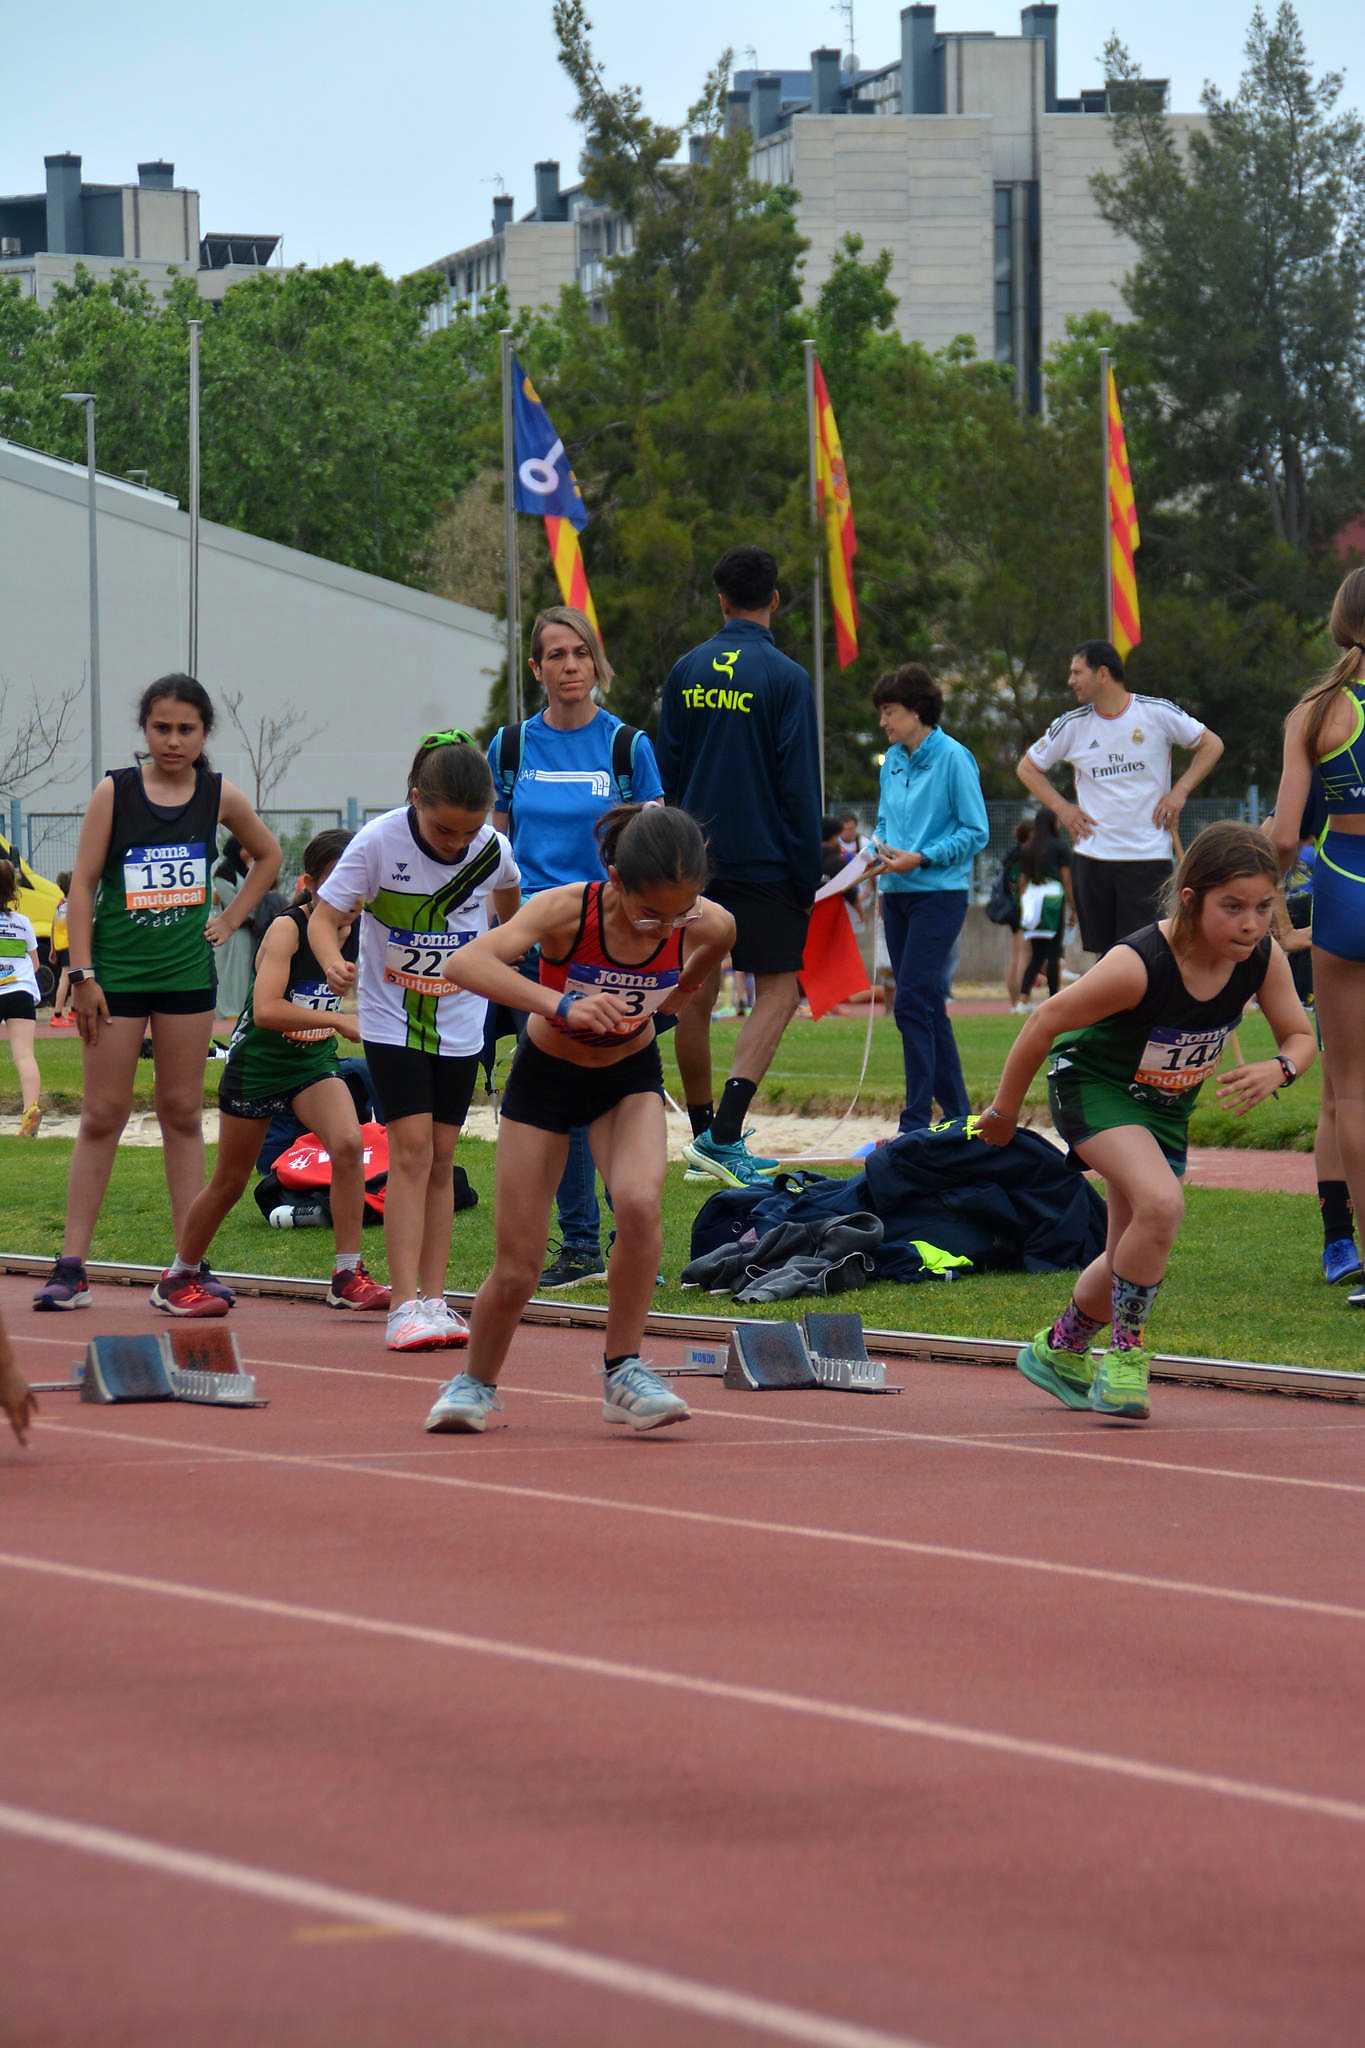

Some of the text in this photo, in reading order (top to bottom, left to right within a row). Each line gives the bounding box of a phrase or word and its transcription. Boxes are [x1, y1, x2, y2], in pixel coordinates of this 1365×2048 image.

[682, 683, 753, 713] TÈCNIC
[1091, 760, 1145, 778] Emirates
[1108, 753, 1124, 763] Fly
[141, 861, 195, 889] 136
[132, 890, 202, 906] mutuacat
[401, 948, 455, 977] 22
[600, 988, 645, 1016] 3
[691, 1351, 715, 1364] MONDO
